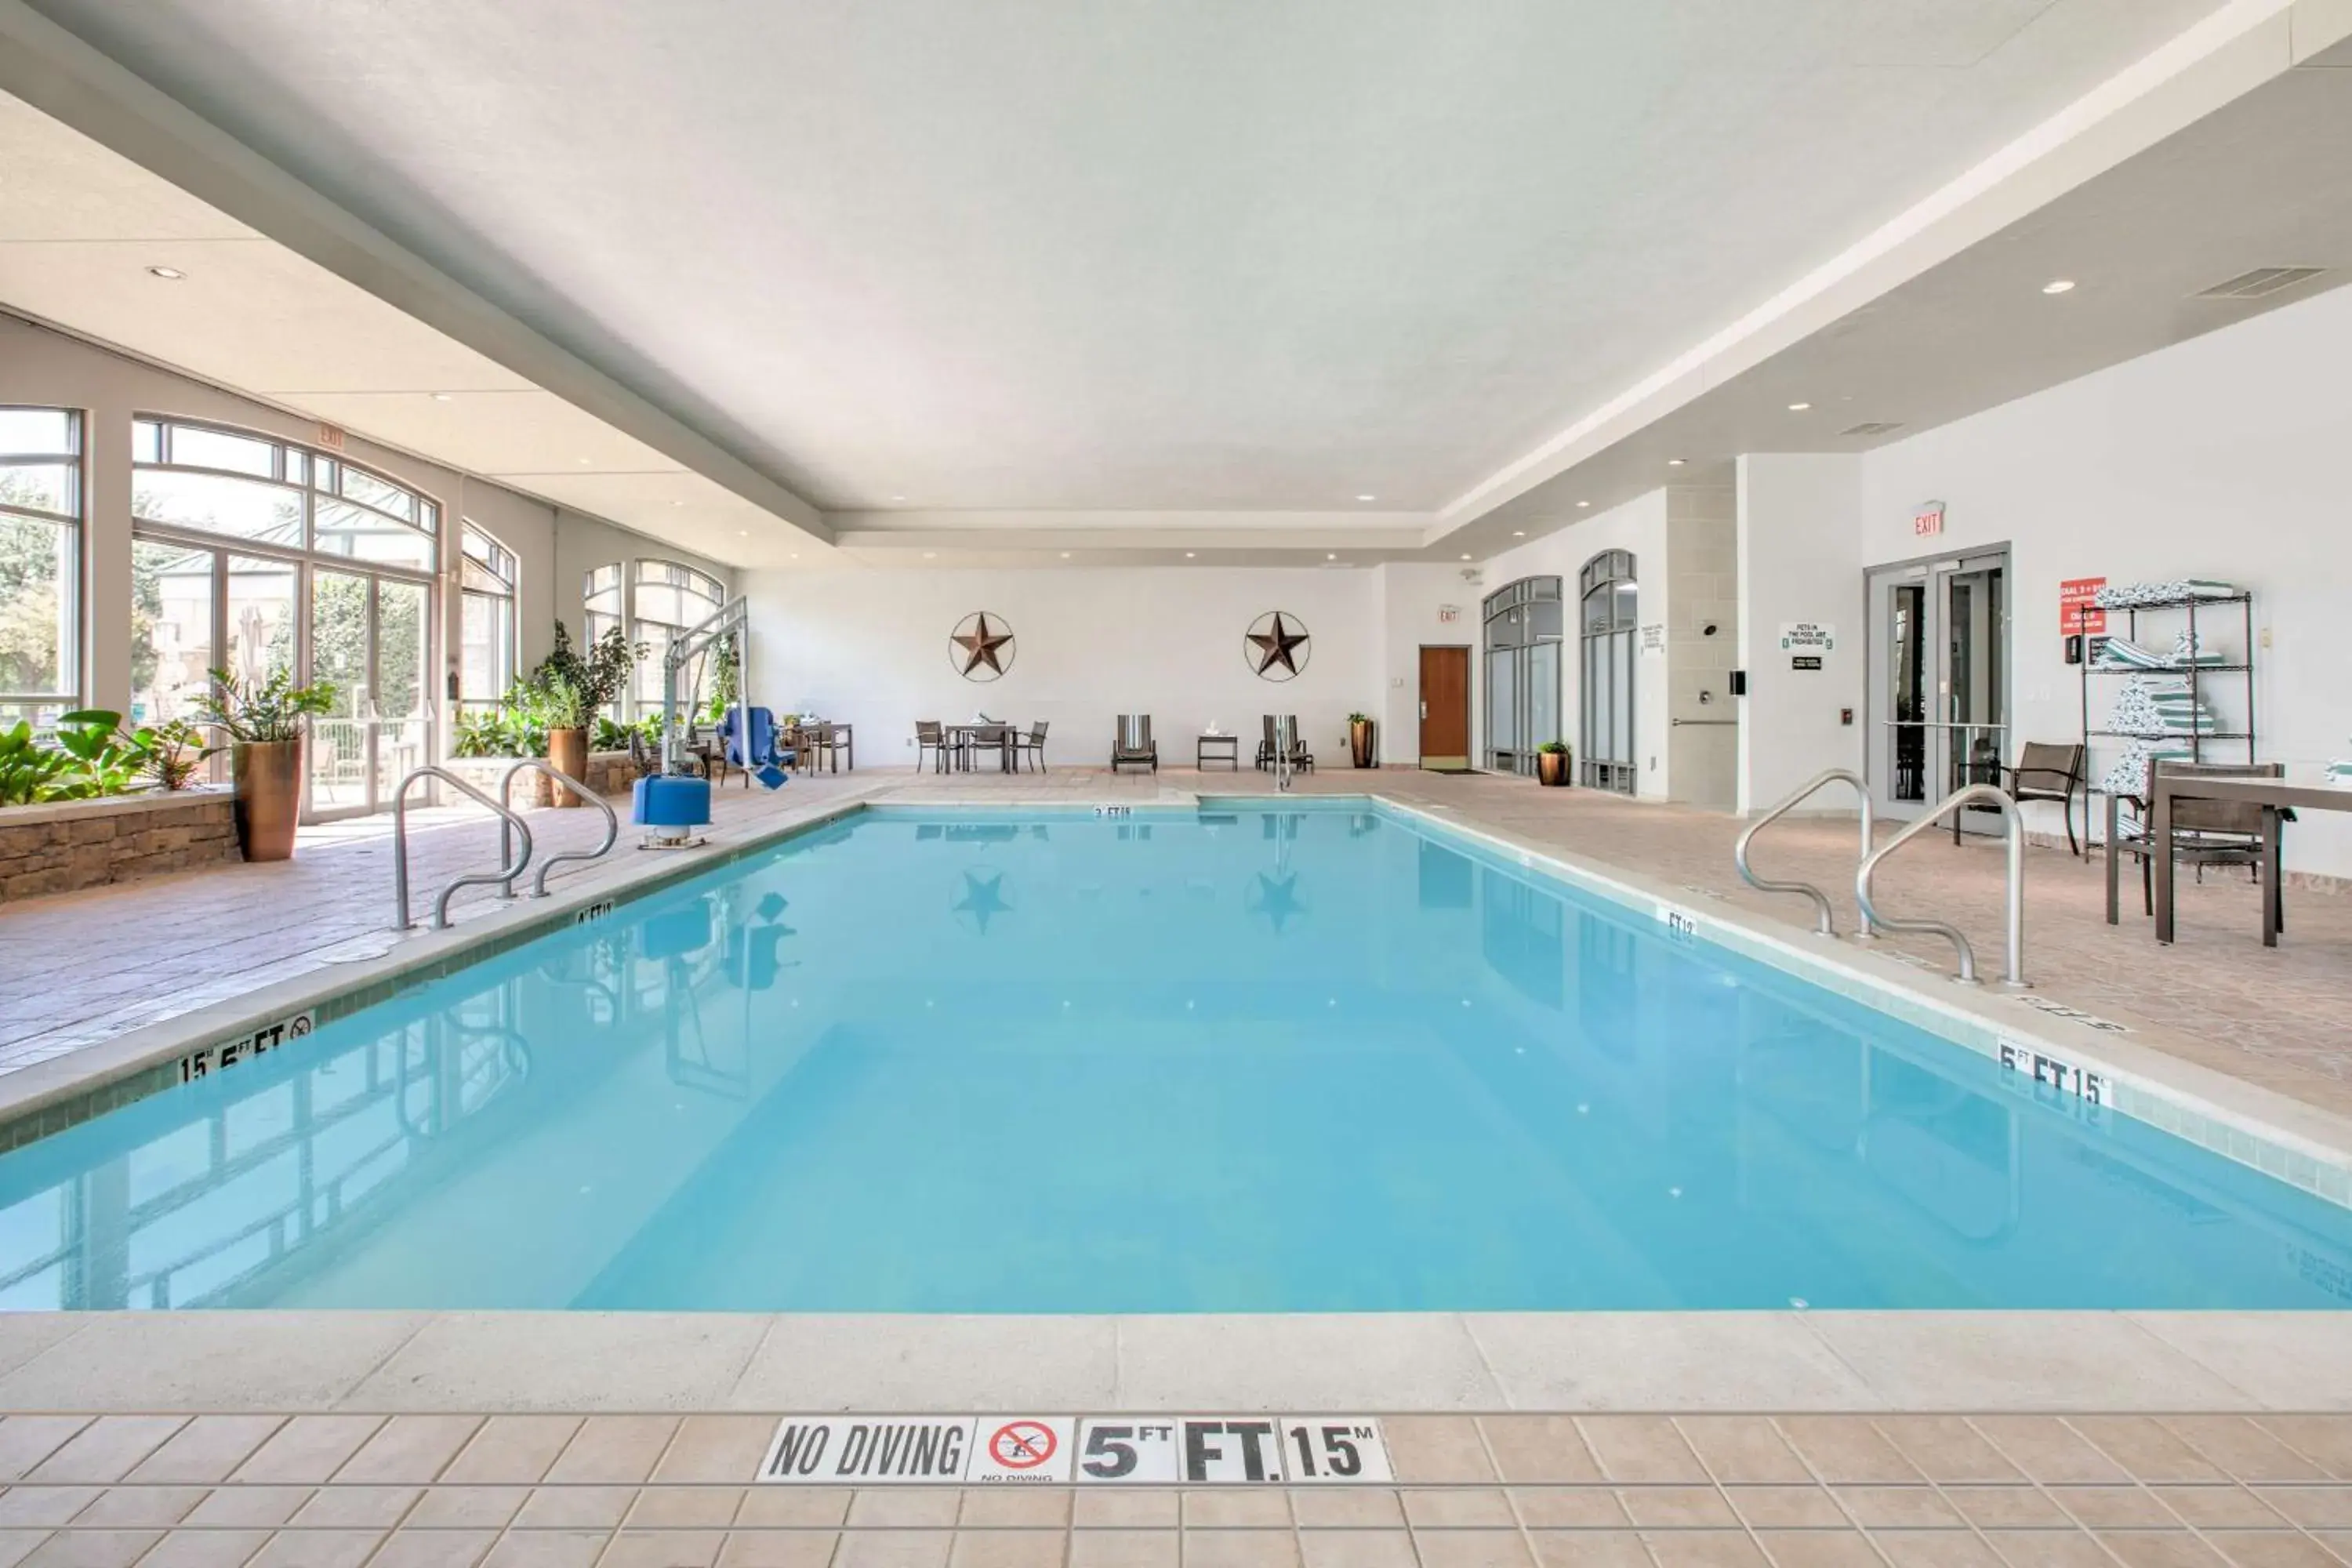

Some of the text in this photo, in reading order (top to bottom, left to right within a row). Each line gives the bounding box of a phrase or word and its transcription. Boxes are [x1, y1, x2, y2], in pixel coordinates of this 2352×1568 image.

[320, 428, 343, 447] EXIT
[1915, 514, 1937, 535] EXIT
[768, 1425, 964, 1476] NO DIVING
